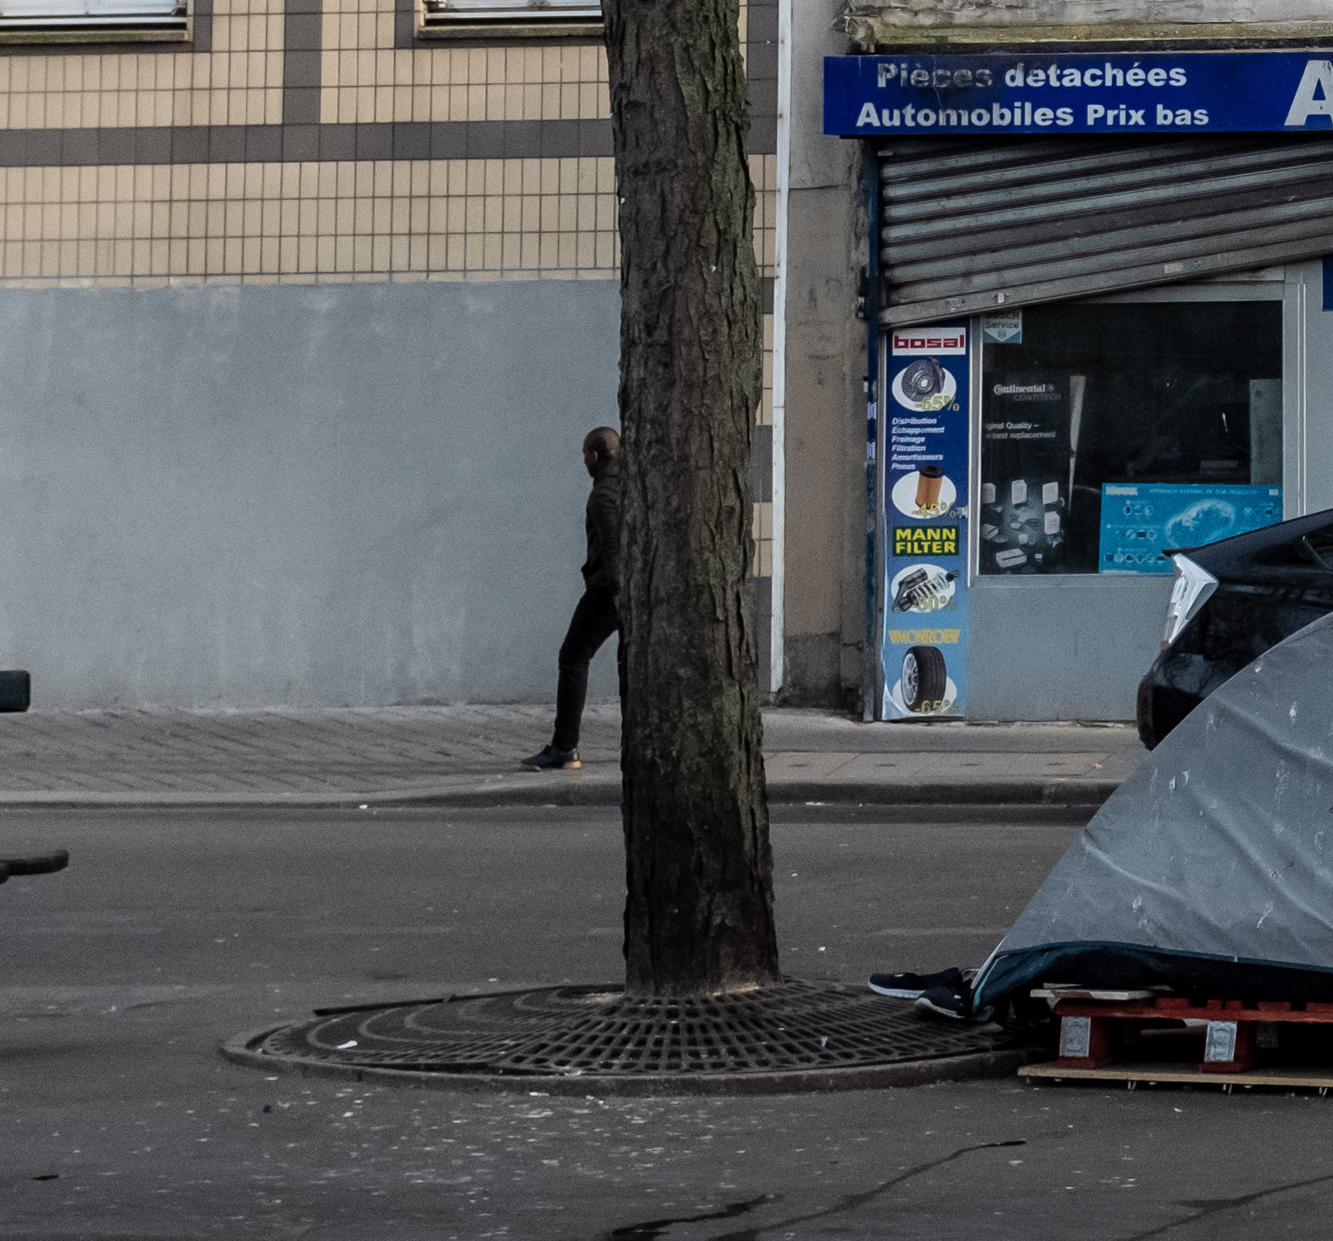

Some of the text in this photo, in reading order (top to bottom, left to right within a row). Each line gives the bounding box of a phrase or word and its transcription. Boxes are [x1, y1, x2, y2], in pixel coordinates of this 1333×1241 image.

[877, 62, 1187, 88] Pièces detachées
[856, 101, 1210, 127] Automobiles Prix bas
[985, 320, 1019, 329] Service
[893, 334, 964, 348] bosal
[993, 384, 1046, 396] Continental
[915, 395, 960, 411] -65%
[892, 417, 937, 425] Distribution
[1006, 422, 1032, 431] Quality
[892, 427, 945, 435] Echappement
[1010, 431, 1056, 441] replacement
[892, 436, 925, 444] Freinage
[896, 528, 956, 540] MANN
[896, 542, 956, 553] FILTER
